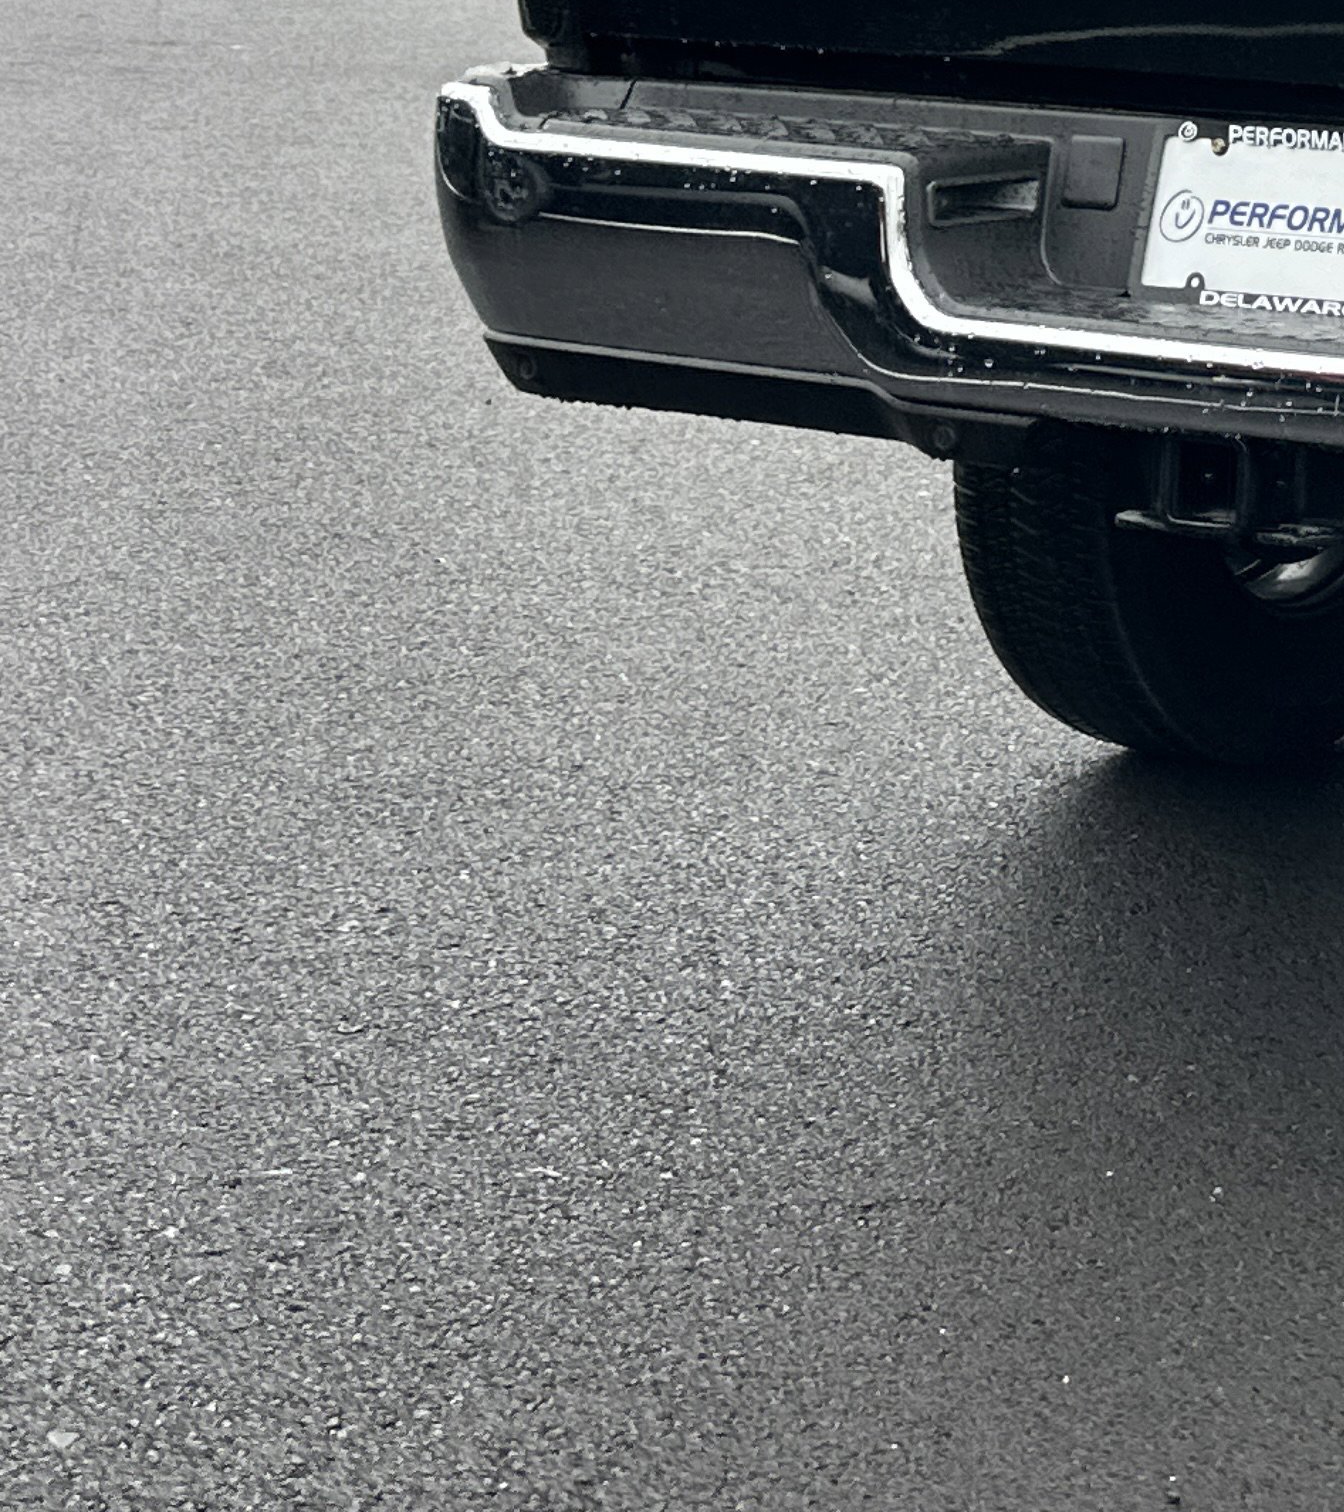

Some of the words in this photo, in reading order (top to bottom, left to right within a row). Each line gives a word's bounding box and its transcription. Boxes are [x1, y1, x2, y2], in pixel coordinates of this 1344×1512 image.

[1204, 232, 1260, 249] CHRYSLER
[1262, 237, 1291, 251] JEEP
[1294, 239, 1334, 255] DODGE
